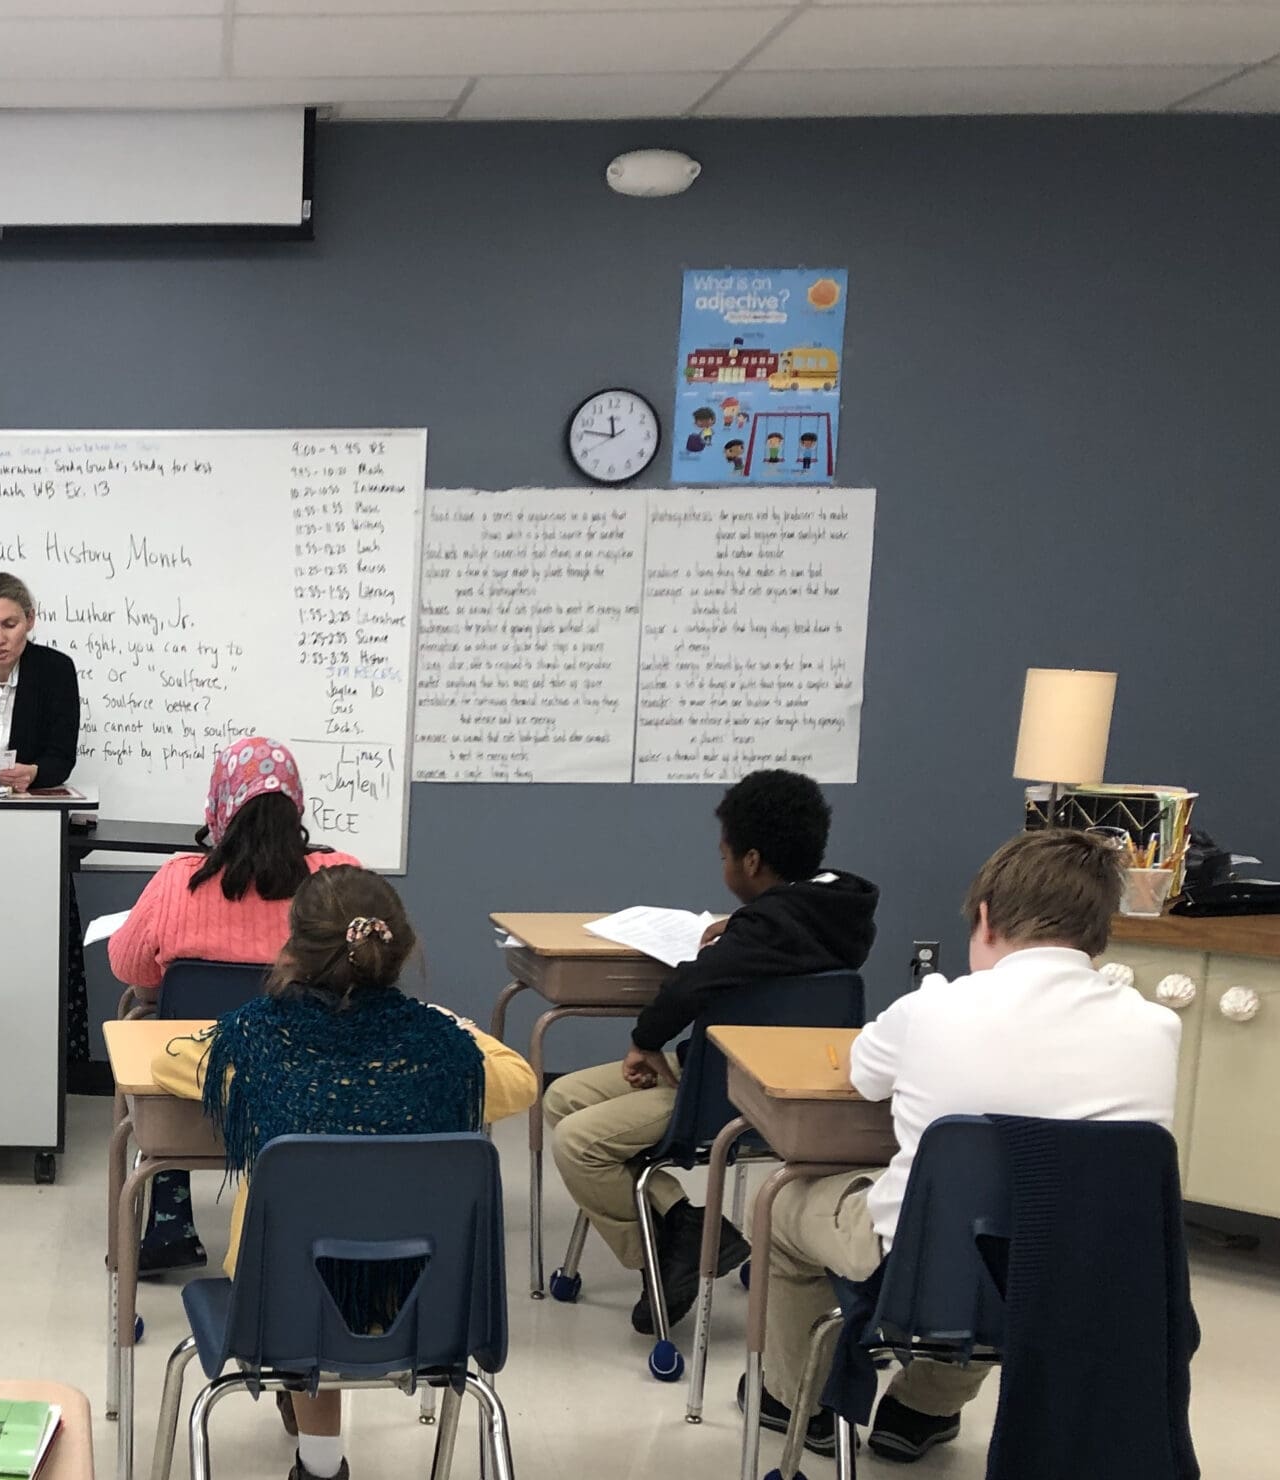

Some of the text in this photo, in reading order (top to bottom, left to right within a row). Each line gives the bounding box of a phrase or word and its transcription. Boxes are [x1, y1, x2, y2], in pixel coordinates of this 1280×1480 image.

[693, 275, 771, 291] What is an
[695, 289, 791, 313] adjective?
[593, 404, 603, 414] 11
[609, 399, 621, 409] 12
[582, 418, 594, 427] 10
[640, 414, 646, 424] 2
[644, 430, 651, 440] 3
[171, 459, 188, 474] for
[594, 460, 600, 470] 7
[33, 480, 55, 498] WB
[65, 481, 86, 498] Ex.
[93, 480, 111, 497] 13
[46, 531, 115, 580] History
[126, 534, 192, 570] Month
[65, 595, 116, 623] Luther
[124, 596, 165, 636] King,
[168, 596, 195, 629] Jr.
[70, 639, 78, 650] a
[127, 642, 155, 667] you
[164, 641, 187, 654] can
[197, 640, 219, 669] try
[229, 642, 244, 657] to
[166, 696, 212, 716] better?
[330, 699, 354, 715] Gus
[104, 719, 144, 734] cannot
[152, 720, 173, 734] win
[182, 719, 197, 739] by
[104, 741, 133, 766] fought
[141, 742, 152, 766] by
[164, 744, 205, 771] physical
[309, 797, 360, 834] RECE
